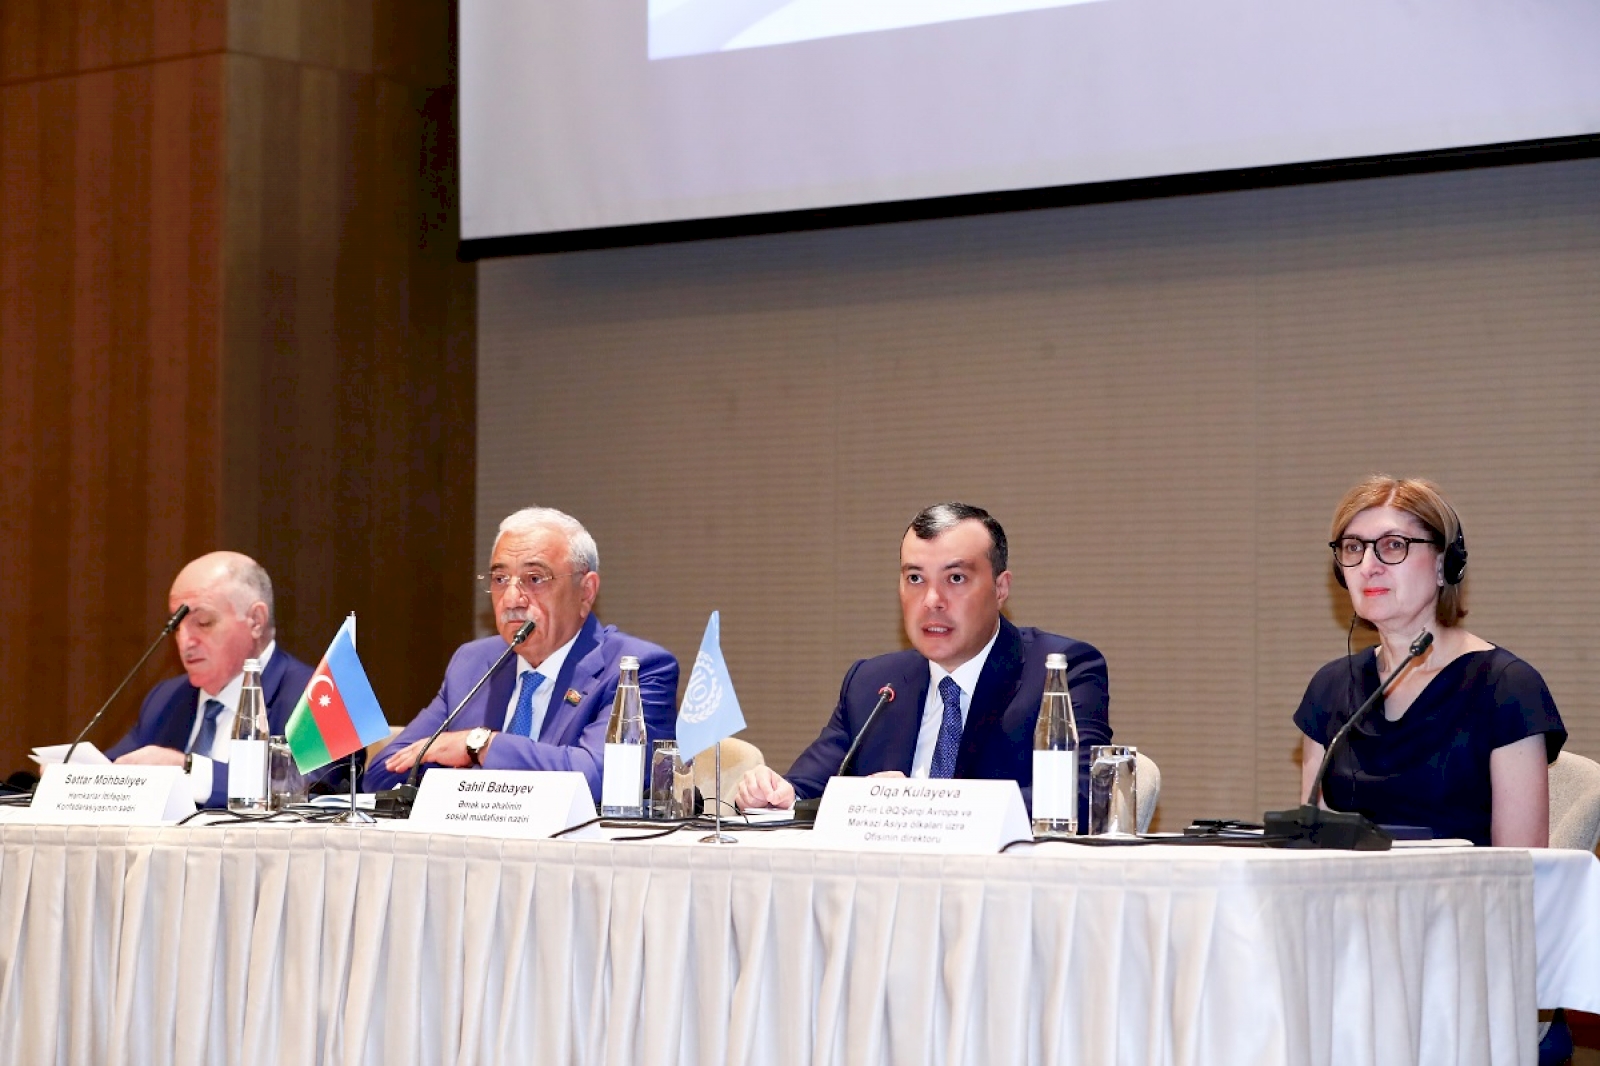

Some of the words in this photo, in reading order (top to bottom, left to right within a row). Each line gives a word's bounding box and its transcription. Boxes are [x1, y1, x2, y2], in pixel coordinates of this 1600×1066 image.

[457, 779, 486, 792] Sahil
[486, 780, 534, 797] Babayev
[869, 784, 900, 799] Olqa
[902, 785, 962, 801] Kulayeva
